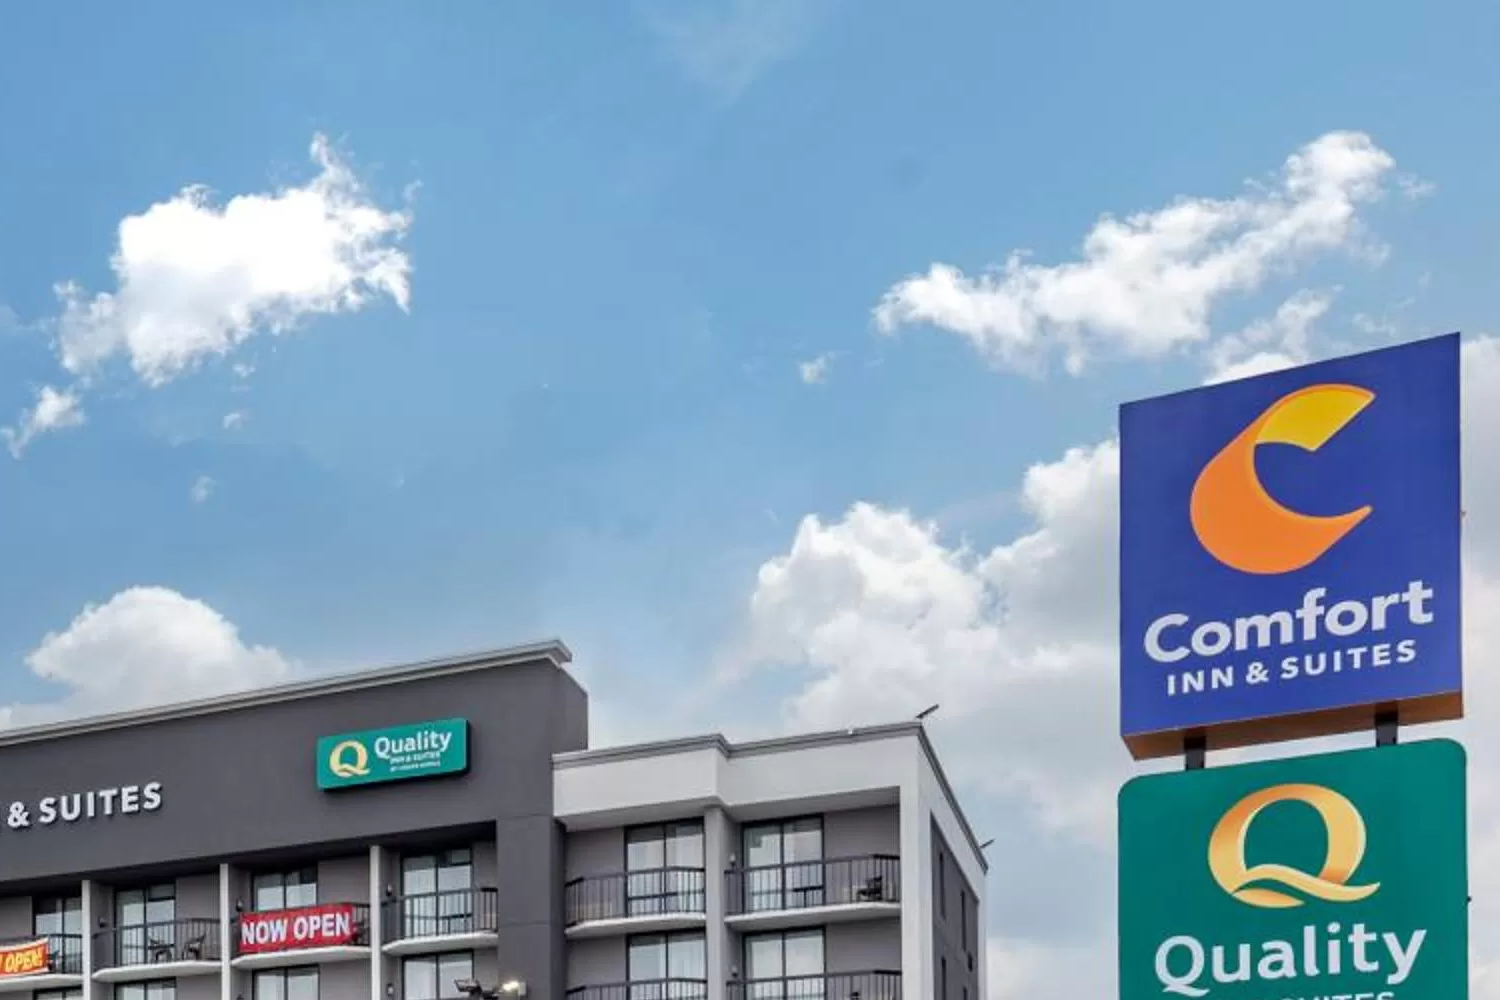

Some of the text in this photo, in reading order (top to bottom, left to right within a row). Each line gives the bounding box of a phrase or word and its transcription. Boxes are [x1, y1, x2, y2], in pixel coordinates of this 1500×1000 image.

[1143, 580, 1434, 663] Comfort
[1167, 639, 1417, 696] INN & SUITES
[374, 731, 452, 760] Quality
[7, 801, 30, 828] &
[40, 781, 162, 822] SUITES
[1208, 783, 1380, 908] Q
[242, 912, 350, 945] NOW OPEN
[5, 945, 44, 972] OPEN
[1155, 922, 1427, 997] Quality
